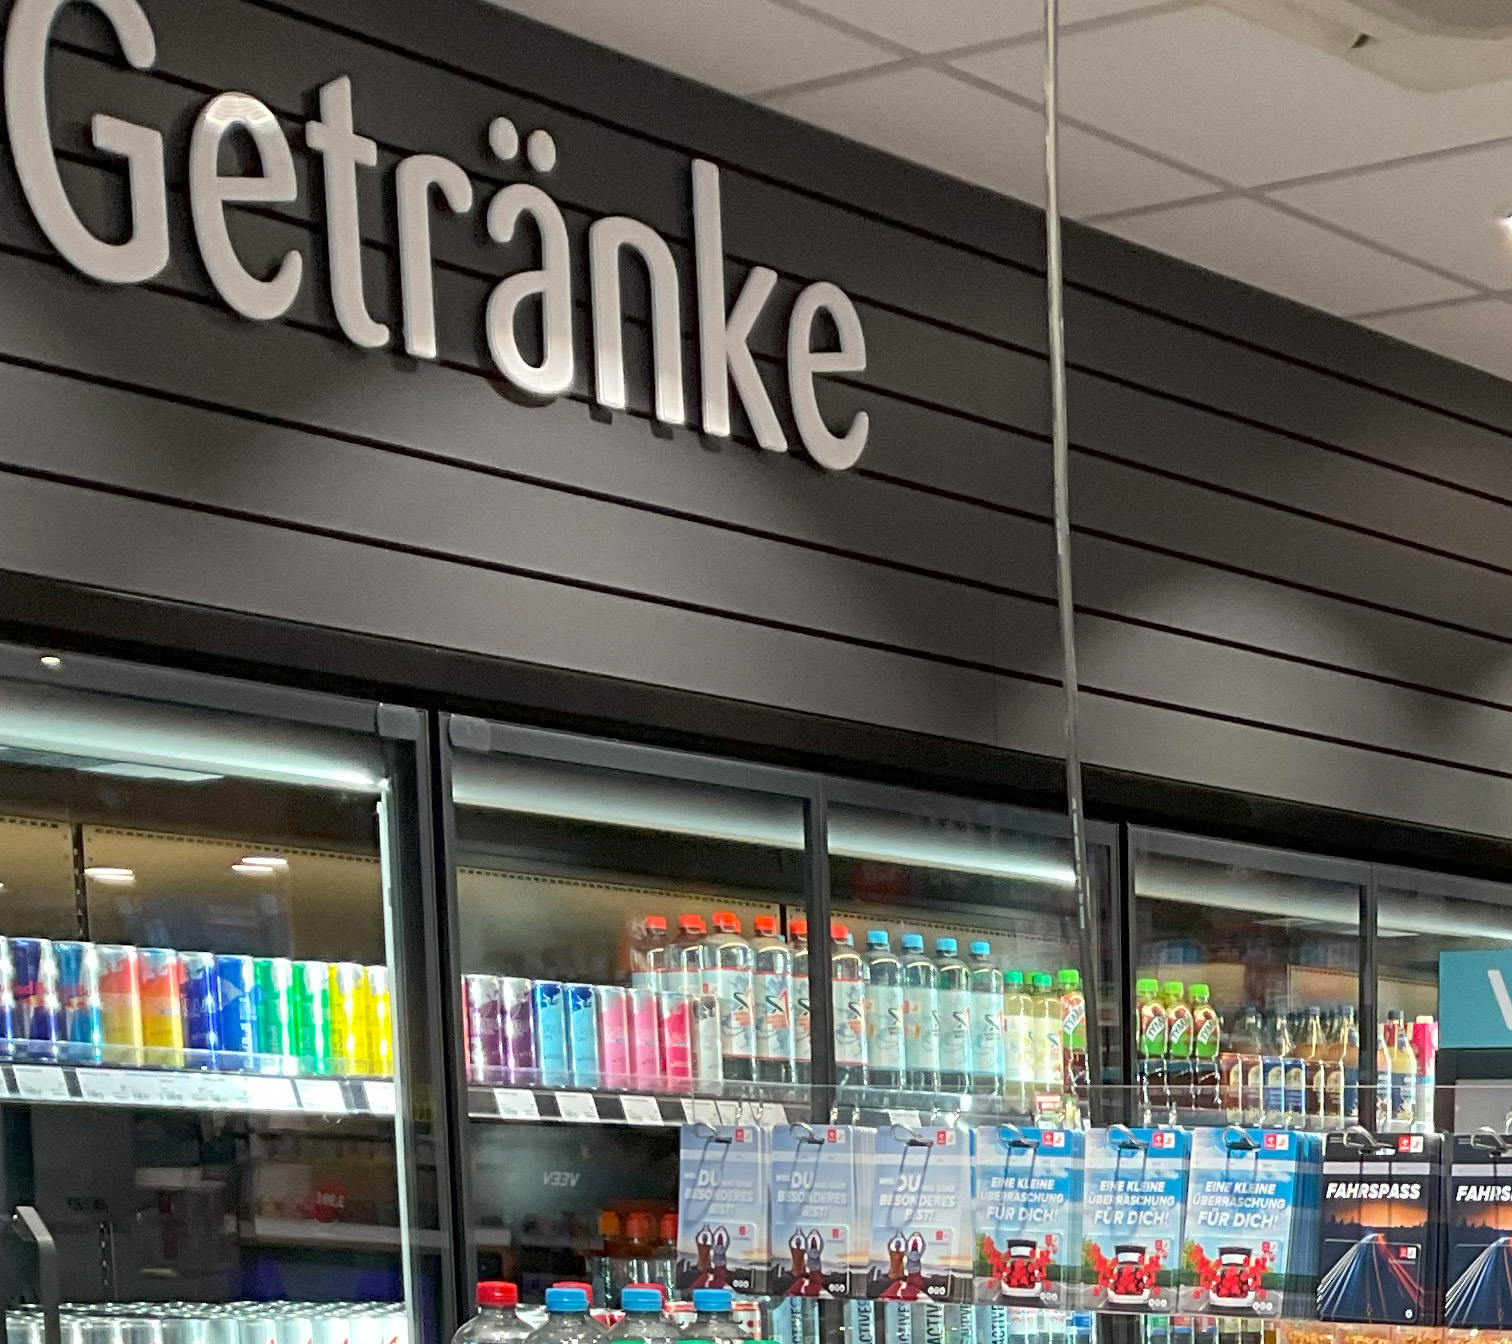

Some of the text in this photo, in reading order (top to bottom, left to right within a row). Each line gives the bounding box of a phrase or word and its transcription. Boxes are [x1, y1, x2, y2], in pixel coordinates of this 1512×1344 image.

[3, 0, 870, 470] Getränke
[990, 1176, 1056, 1192] EINE KLEINE
[1099, 1180, 1166, 1194] EINE KLEINE
[1204, 1180, 1277, 1196] EINE KLEINE
[1325, 1182, 1422, 1201] FAHRSPASS
[979, 1188, 1065, 1204] ÜBERRASCHUNG
[1088, 1191, 1176, 1208] ÜBERRASCHUNG
[1191, 1192, 1287, 1211] ÜBERRASCHUNG
[985, 1203, 1060, 1225] FÜR DICH!
[1093, 1204, 1171, 1228] FÜR DICH!
[1196, 1206, 1279, 1230] FÜR DICH!
